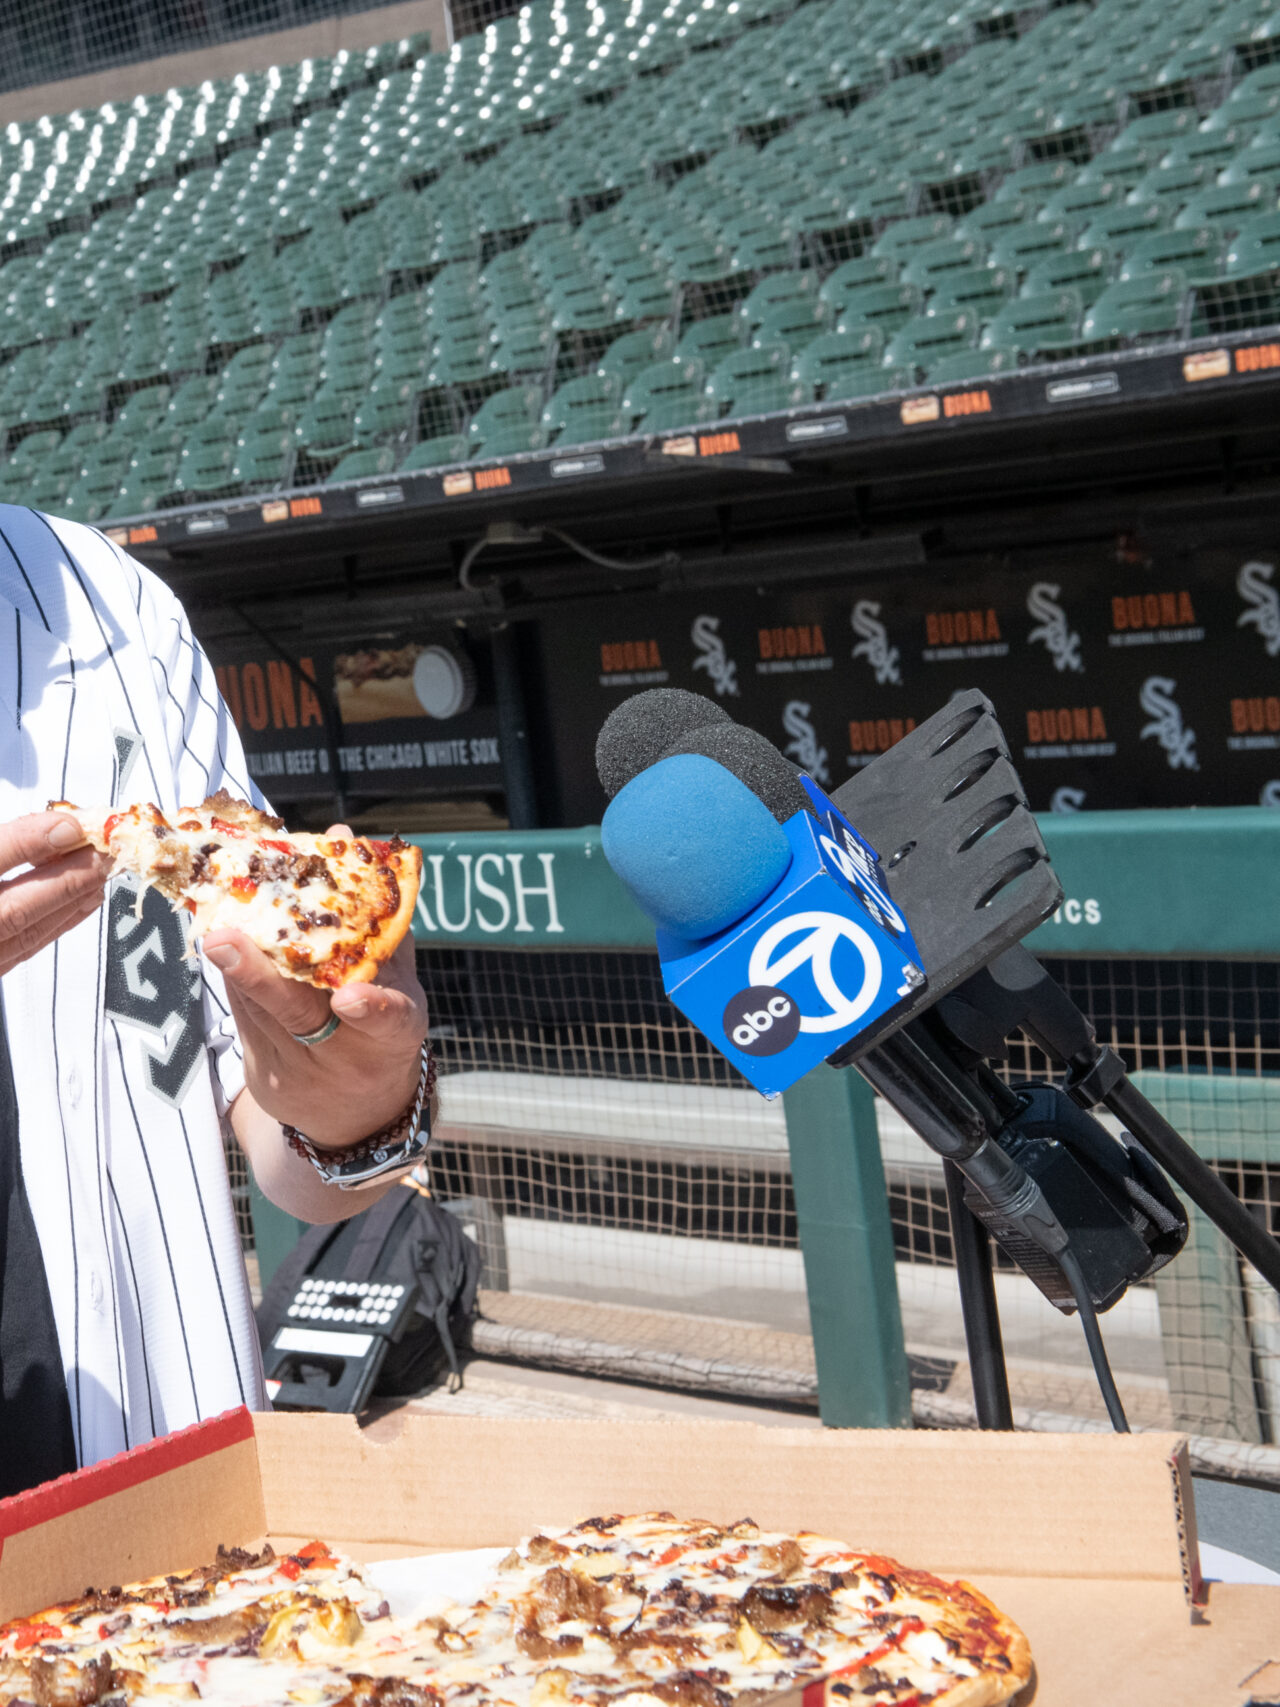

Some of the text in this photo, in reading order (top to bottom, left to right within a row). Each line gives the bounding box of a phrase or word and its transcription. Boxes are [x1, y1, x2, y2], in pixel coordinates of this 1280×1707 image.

[926, 608, 1001, 645] BUONA
[1112, 591, 1196, 630] BUONA
[758, 625, 826, 659] BUONA
[1026, 706, 1107, 742] BUONA
[285, 748, 317, 775] BEEF
[319, 747, 330, 773] O
[337, 746, 364, 772] THE
[366, 742, 423, 770] CHICAGO
[423, 739, 469, 767] WHITE
[470, 737, 500, 765] SOX
[749, 911, 882, 1034] 7
[732, 996, 792, 1047] abc
